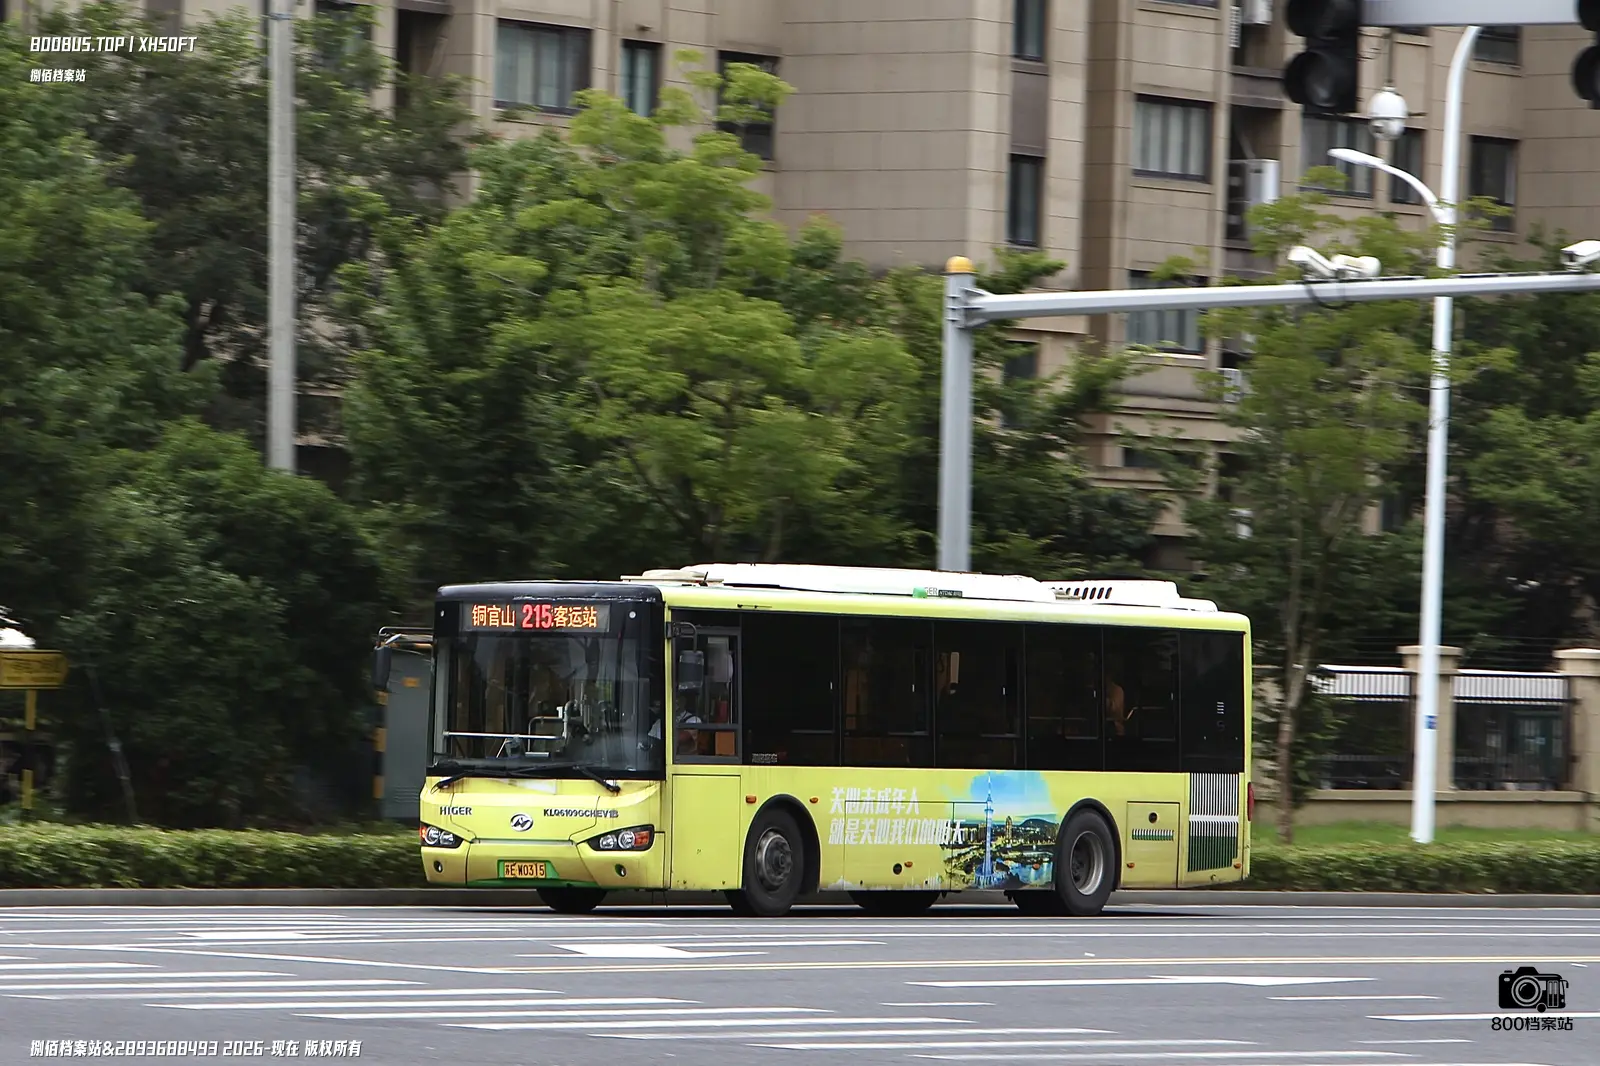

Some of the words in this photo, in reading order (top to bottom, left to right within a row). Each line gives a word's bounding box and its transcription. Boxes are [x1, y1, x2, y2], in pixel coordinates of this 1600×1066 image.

[472, 605, 515, 627] 铜官山
[522, 604, 552, 628] 215
[554, 605, 597, 627] 客运站
[440, 806, 472, 816] HIGER
[828, 818, 966, 845] 就是关心我们的明天
